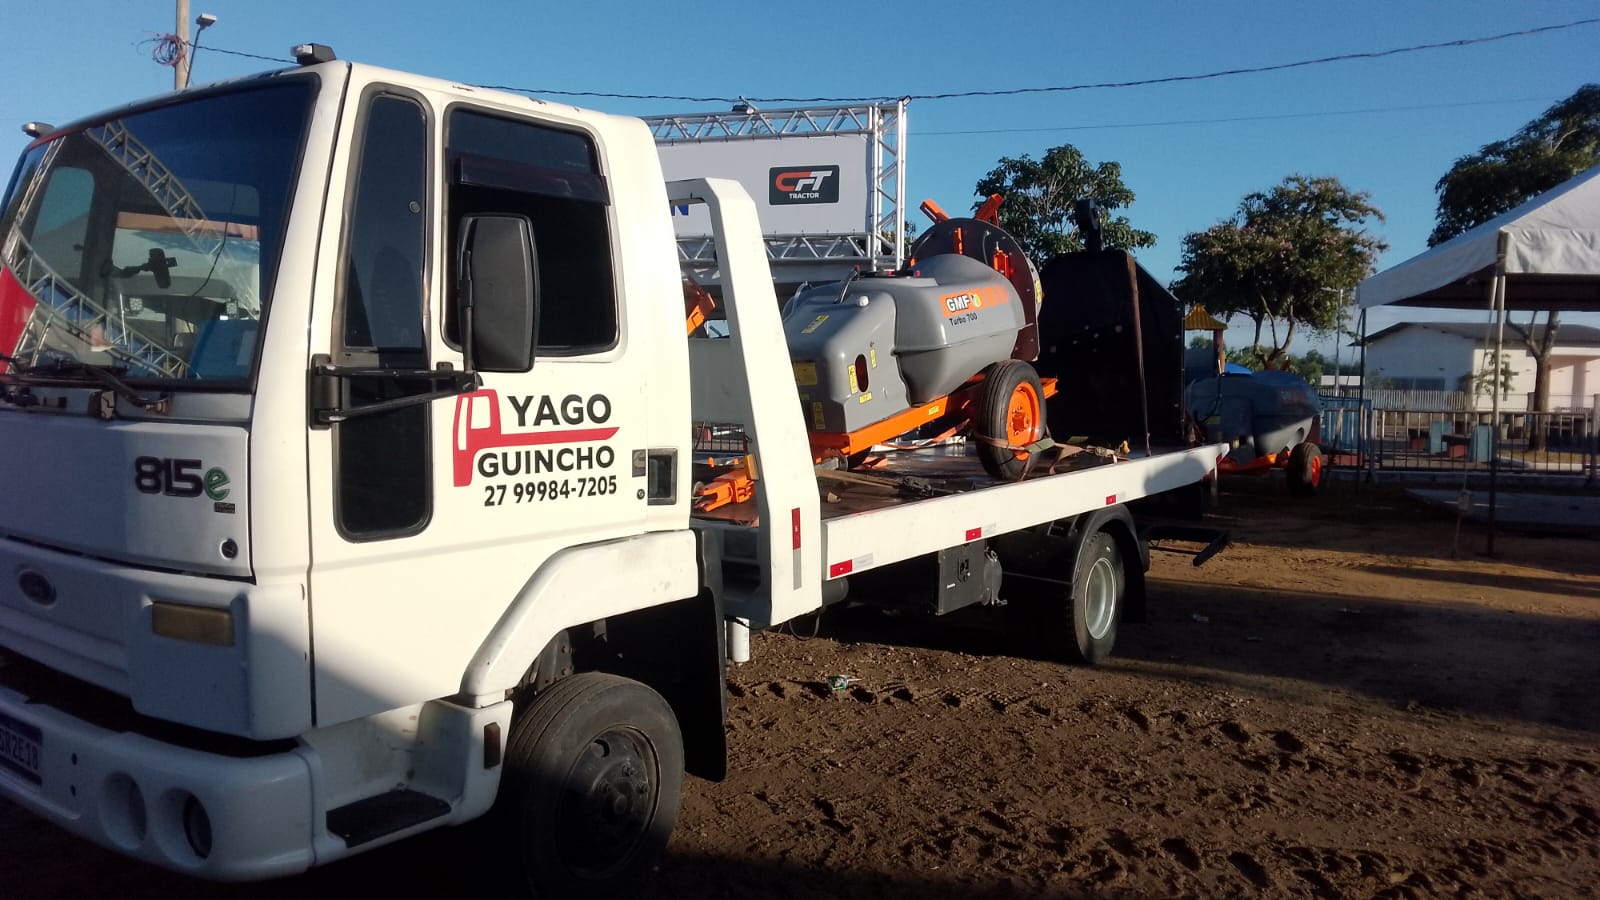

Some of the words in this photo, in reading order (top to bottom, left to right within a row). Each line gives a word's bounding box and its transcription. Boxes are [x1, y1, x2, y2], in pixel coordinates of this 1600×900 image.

[775, 170, 832, 191] CFT
[946, 294, 971, 312] GMF
[949, 316, 966, 326] Turbo
[966, 312, 978, 321] 700
[507, 393, 612, 427] YAGO
[477, 445, 615, 478] GUINCHO
[484, 484, 507, 507] 27
[513, 475, 617, 504] 99984-7205
